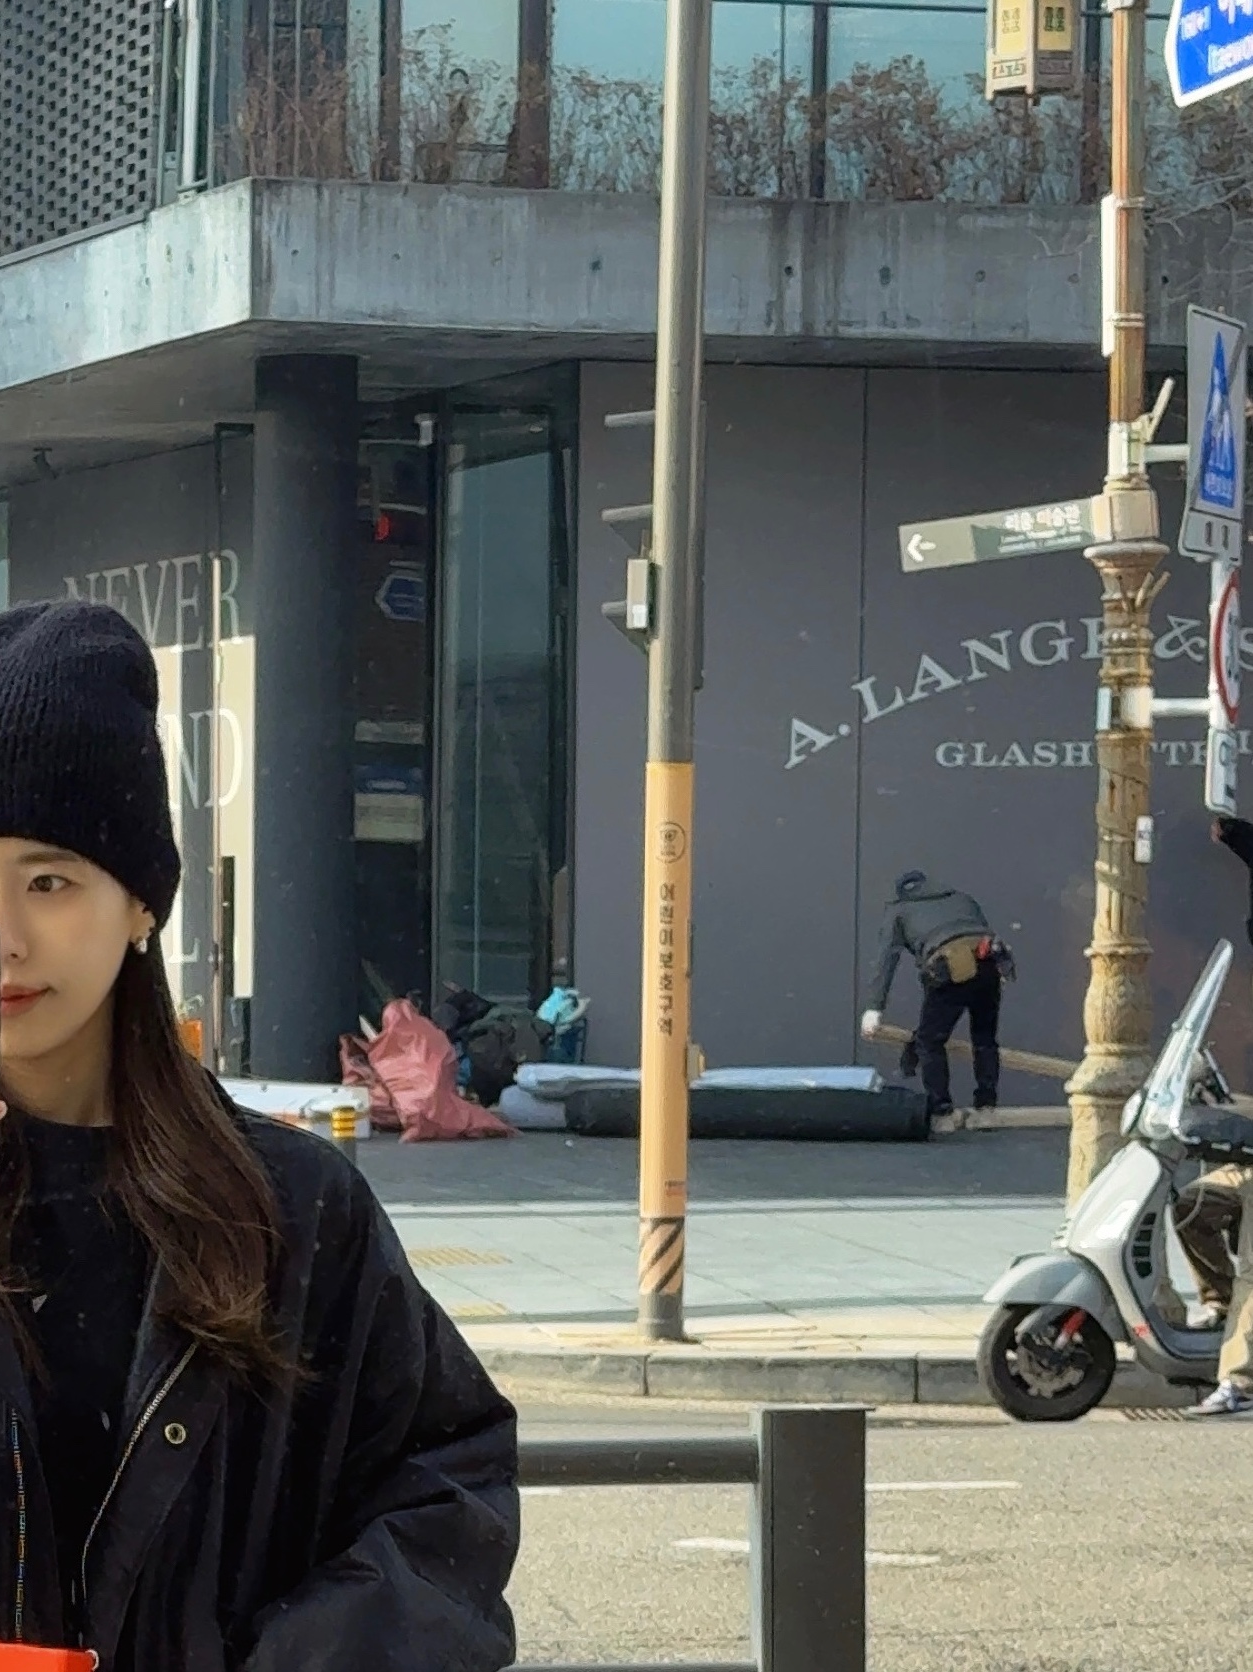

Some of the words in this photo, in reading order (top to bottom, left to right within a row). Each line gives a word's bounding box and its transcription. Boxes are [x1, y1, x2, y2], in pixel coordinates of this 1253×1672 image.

[784, 717, 851, 769] A.
[1154, 614, 1206, 662] &
[658, 882, 676, 1037] 어린이보호구역
